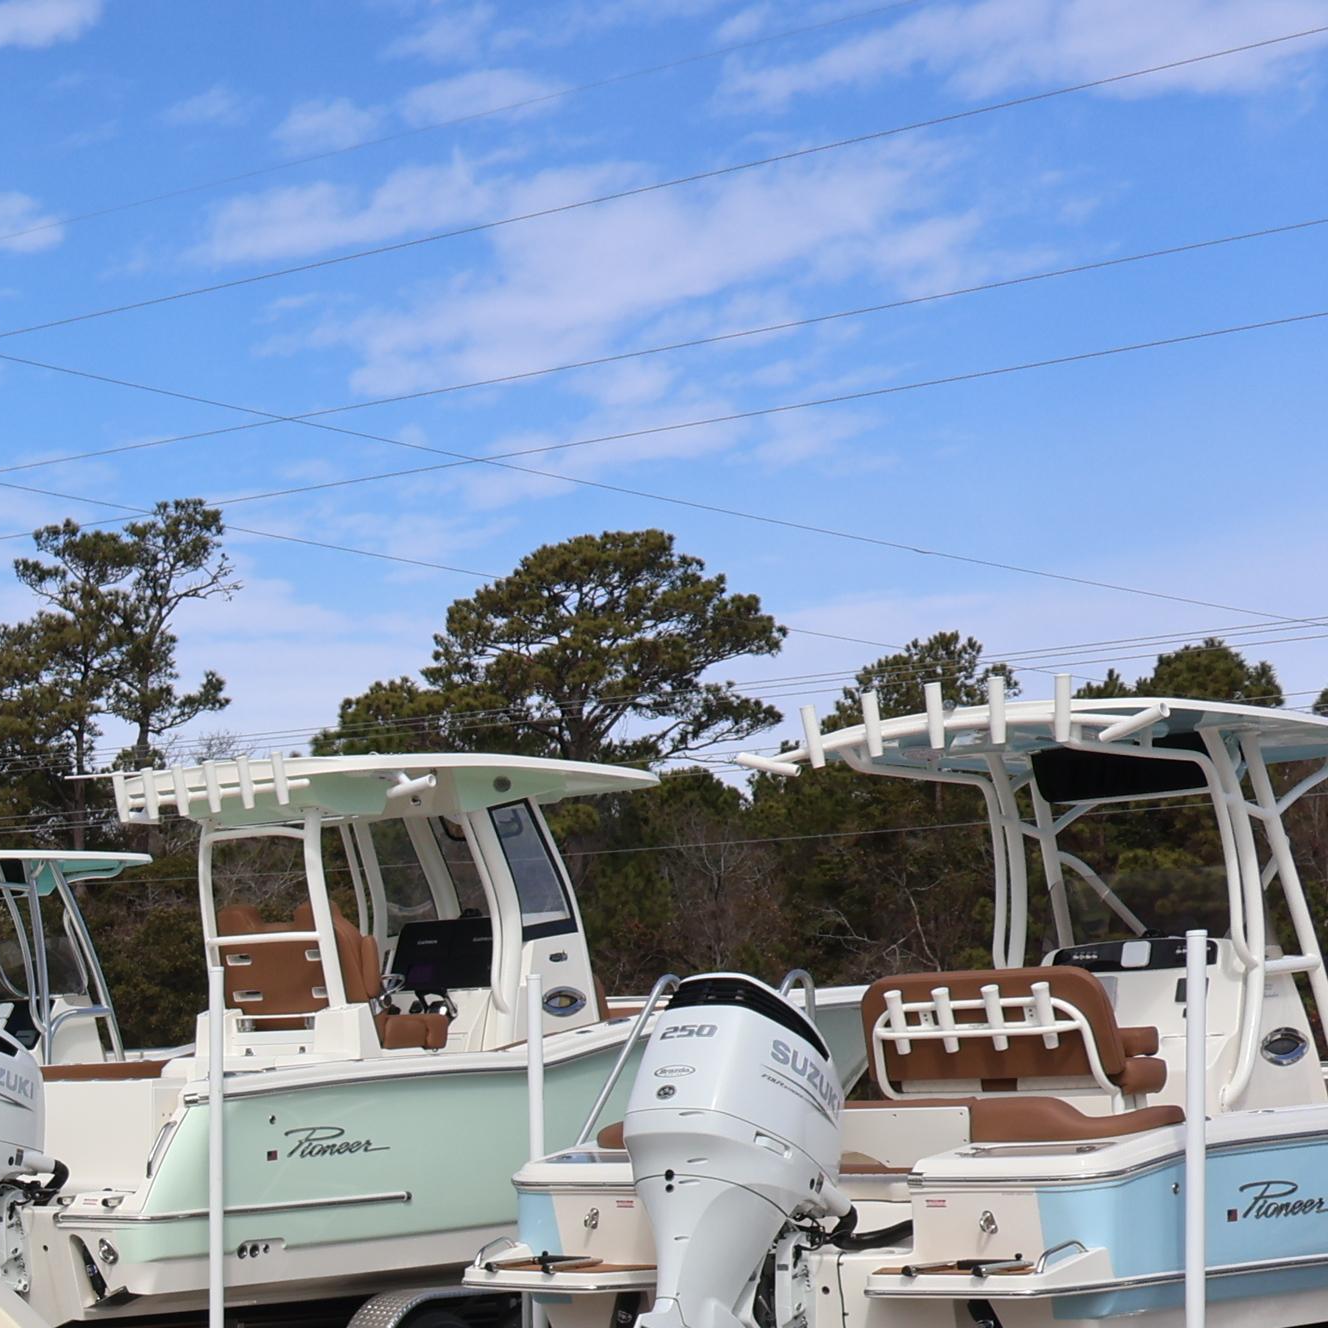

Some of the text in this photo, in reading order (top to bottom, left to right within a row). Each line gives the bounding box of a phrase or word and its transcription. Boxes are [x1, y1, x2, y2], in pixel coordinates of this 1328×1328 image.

[659, 1024, 719, 1040] 250
[770, 1039, 840, 1120] SUZUKI
[284, 1126, 390, 1158] Pioneer
[1239, 1181, 1328, 1219] Pioneer
